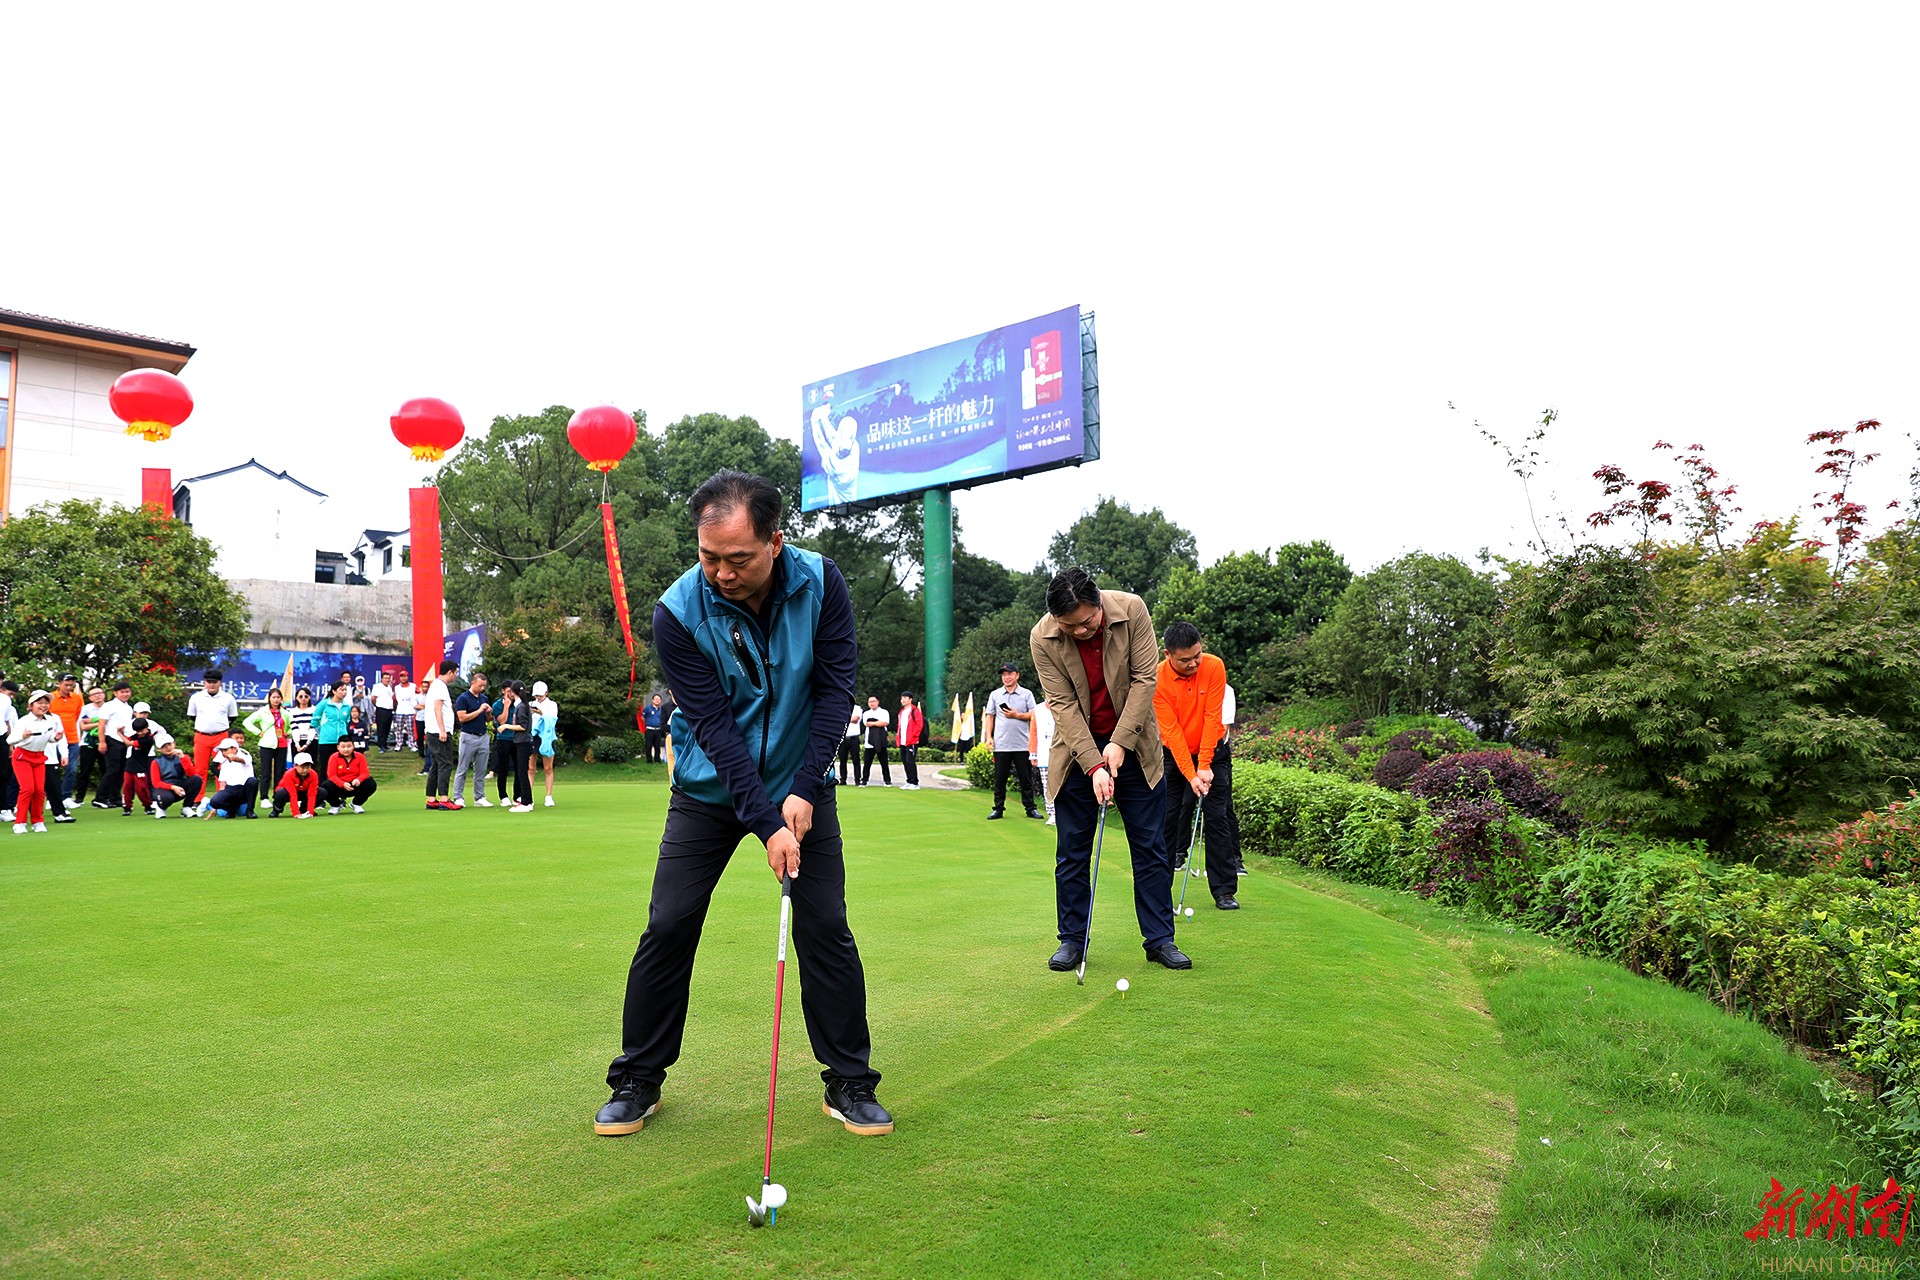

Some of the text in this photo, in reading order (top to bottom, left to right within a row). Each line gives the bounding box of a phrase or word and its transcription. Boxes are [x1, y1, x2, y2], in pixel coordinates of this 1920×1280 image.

[867, 394, 994, 444] 品味这一杆的魅力
